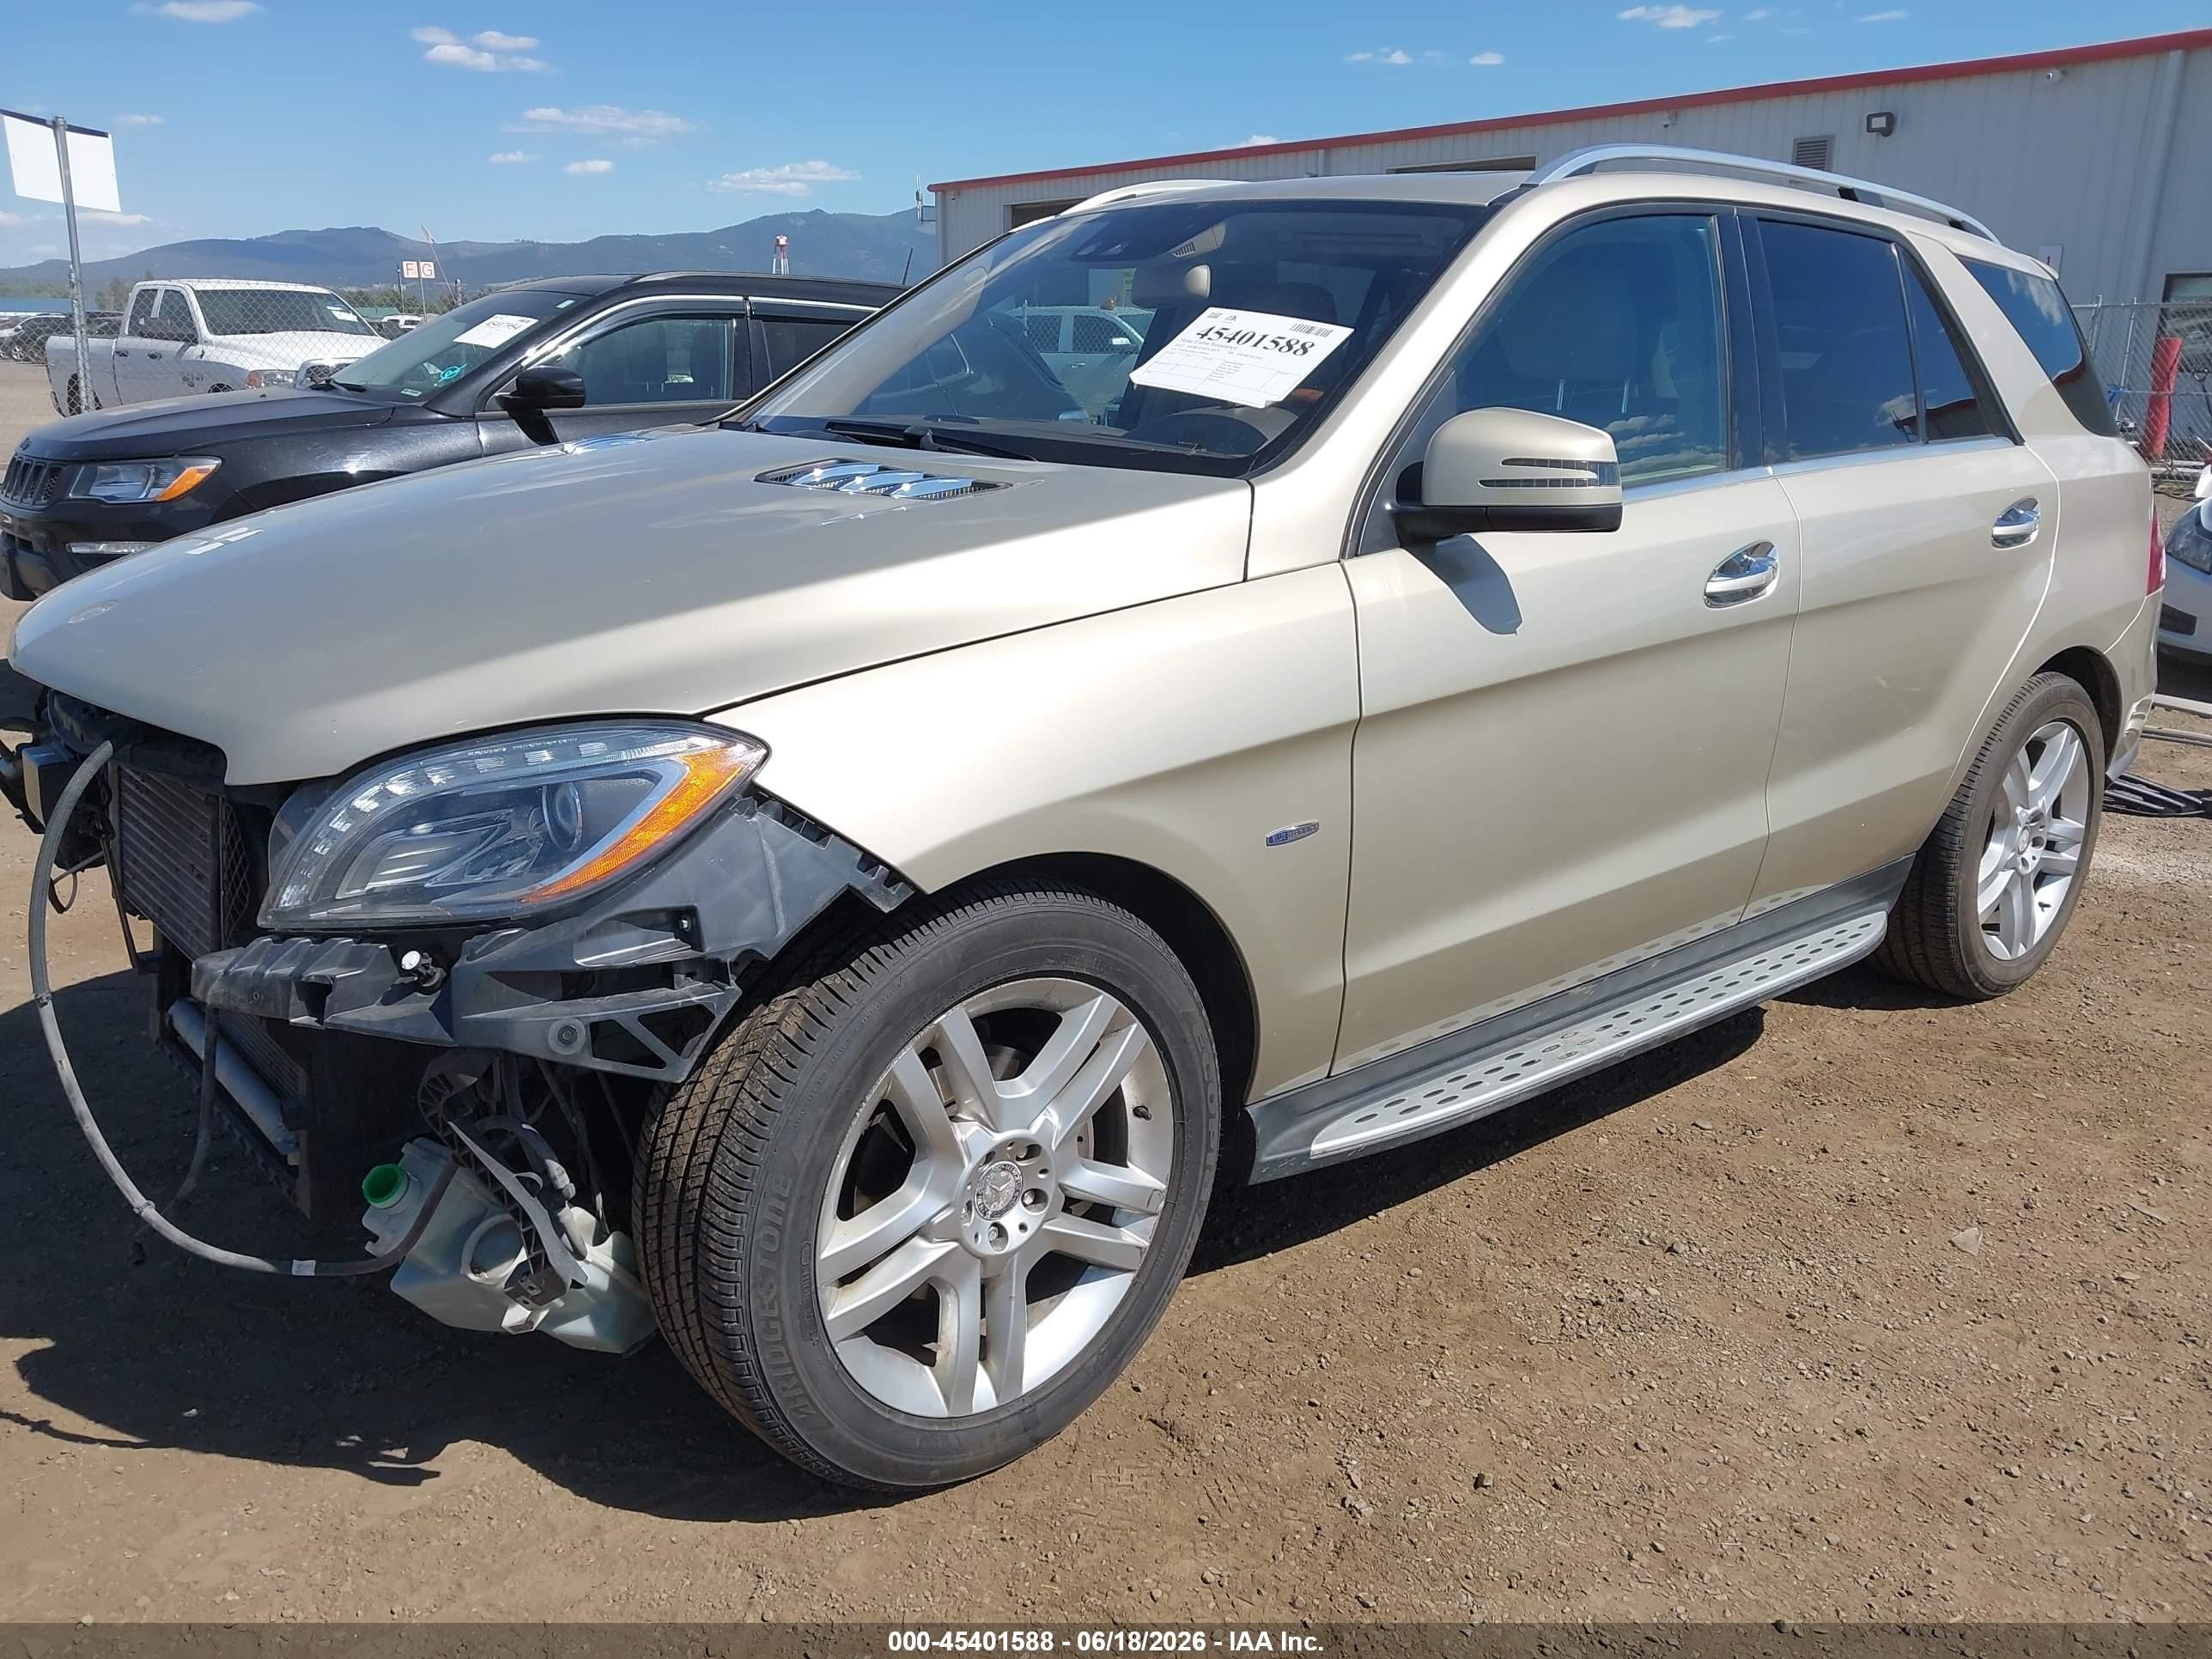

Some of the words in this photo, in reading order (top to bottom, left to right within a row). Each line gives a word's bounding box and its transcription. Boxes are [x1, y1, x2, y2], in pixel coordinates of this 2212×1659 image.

[406, 263, 415, 276] F
[422, 264, 433, 276] G
[1196, 325, 1315, 356] 45401588
